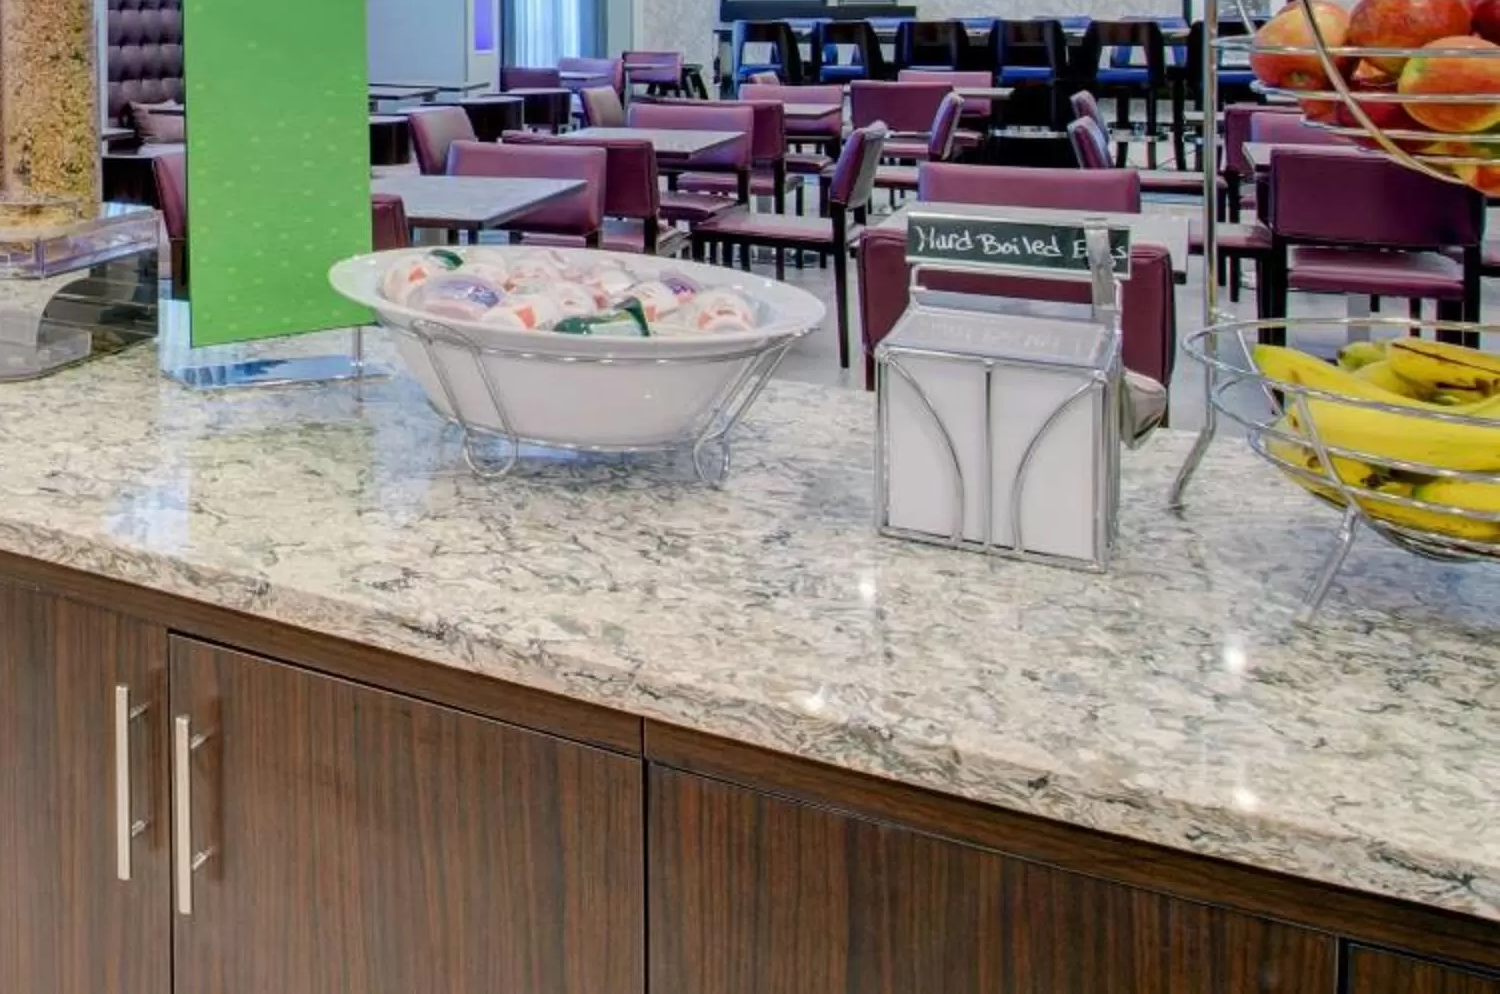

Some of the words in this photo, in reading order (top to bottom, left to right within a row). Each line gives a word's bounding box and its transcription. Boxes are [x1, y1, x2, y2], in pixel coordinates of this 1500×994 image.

[914, 225, 974, 253] Hard
[976, 233, 1063, 258] Boiled
[1071, 239, 1127, 268] Es
